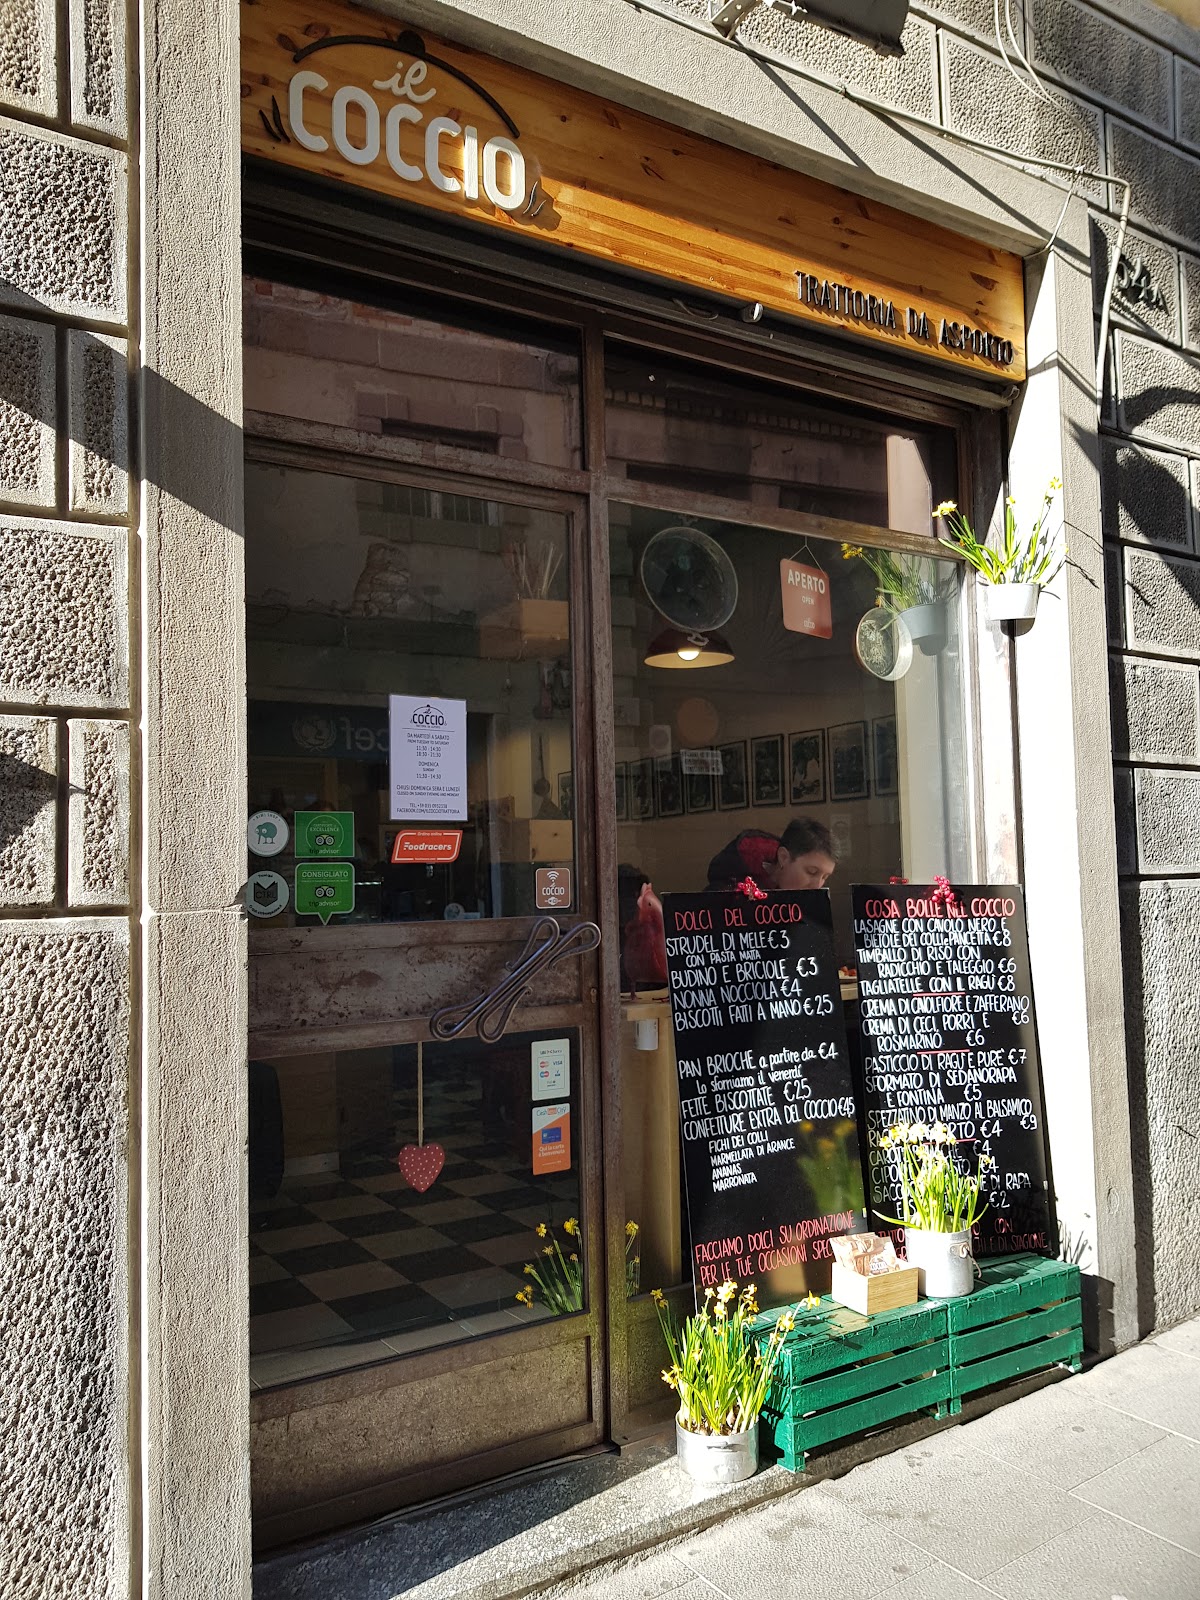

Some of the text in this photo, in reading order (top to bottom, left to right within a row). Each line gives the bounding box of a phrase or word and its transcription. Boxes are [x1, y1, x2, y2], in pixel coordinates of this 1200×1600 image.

[289, 70, 526, 210] COCCIO
[794, 270, 1014, 366] TRATTORIA DA ASPORTO
[787, 569, 826, 594] APERTO
[801, 595, 815, 605] OPEN
[412, 713, 444, 726] COCCIO
[403, 842, 452, 851] Foodracers
[542, 887, 564, 895] COCCIO
[675, 904, 802, 931] DOLCI DEL COCCIO
[866, 899, 900, 918] COSA
[906, 898, 943, 918] BOLLE
[971, 898, 1015, 917] COCCIO
[855, 917, 1007, 934] LASAGNE CON CAVOLO NERO E
[666, 930, 790, 957] STRUDEL DI MELE €3
[864, 933, 900, 948] BIETOLE
[902, 933, 918, 947] DEI
[920, 932, 943, 946] COLLI
[949, 932, 992, 946] PANCETTA
[993, 931, 1011, 947] €8
[686, 950, 761, 968] CON PASTA MATTA
[856, 946, 981, 963] TIMBALLO DI RISO CON
[671, 957, 818, 989] BUDINO E BRICIOLE €3
[877, 958, 1016, 978] RADICCHIO E TALEGGIO €6
[674, 978, 802, 1010] NONNA NOCCIOLA €4
[859, 977, 923, 996] TAGLIATELLE
[929, 977, 952, 992] CON
[956, 977, 965, 990] IL
[998, 975, 1015, 991] €8
[674, 1006, 723, 1031] BISCOTTI
[729, 1004, 752, 1024] FATTI
[757, 1005, 766, 1020] A
[770, 999, 800, 1019] MANO
[861, 995, 1030, 1018] CREMA DI CAVOLFIORE E ZAFFERANO
[862, 1018, 897, 1036] CREMA
[898, 1017, 911, 1034] DI
[942, 1013, 975, 1031] PORRI
[983, 1013, 990, 1027] E
[1012, 1011, 1029, 1025] €6
[877, 1029, 985, 1053] ROSMARINO €6
[679, 1042, 838, 1079] PAN BRIOCHE a partire da €4
[865, 1054, 918, 1074] PASTICCIO
[921, 1054, 932, 1071] DI
[968, 1053, 975, 1068] E
[1008, 1049, 1027, 1065] €7
[711, 1075, 754, 1092] sforniamo
[757, 1071, 765, 1085] il
[865, 1067, 1017, 1093] SFORMATO DI SEDANORAPA
[682, 1096, 711, 1119] FETTE
[716, 1086, 775, 1113] BISCOTTATE
[886, 1083, 982, 1108] E FONTINA €5
[683, 1111, 746, 1141] CONFETTURE
[749, 1107, 782, 1130] EXTRA
[784, 1103, 802, 1123] DEL
[804, 1100, 837, 1120] COCCIO
[867, 1098, 1032, 1130] SPEZZATINO DI MANZO AL BALSAMICO
[1020, 1115, 1037, 1130] €9
[980, 1120, 1003, 1139] €4
[708, 1131, 769, 1153] FICHI DEI COLLI
[710, 1138, 795, 1167] MARMELLATA DI ARANCE
[973, 1140, 992, 1156] €4
[542, 1149, 565, 1157] benvenuta
[712, 1163, 742, 1180] ANANAS
[713, 1172, 757, 1192] MARRONATA
[991, 1174, 1000, 1190] DI
[1005, 1173, 1031, 1190] RAPA
[989, 1190, 1010, 1208] €2
[695, 1210, 856, 1264] FACCIAMO DOLCI SU ORDINAZIONE
[1011, 1232, 1048, 1251] STAGIONE
[700, 1244, 807, 1286] PER LE TUE OCCASIONI
